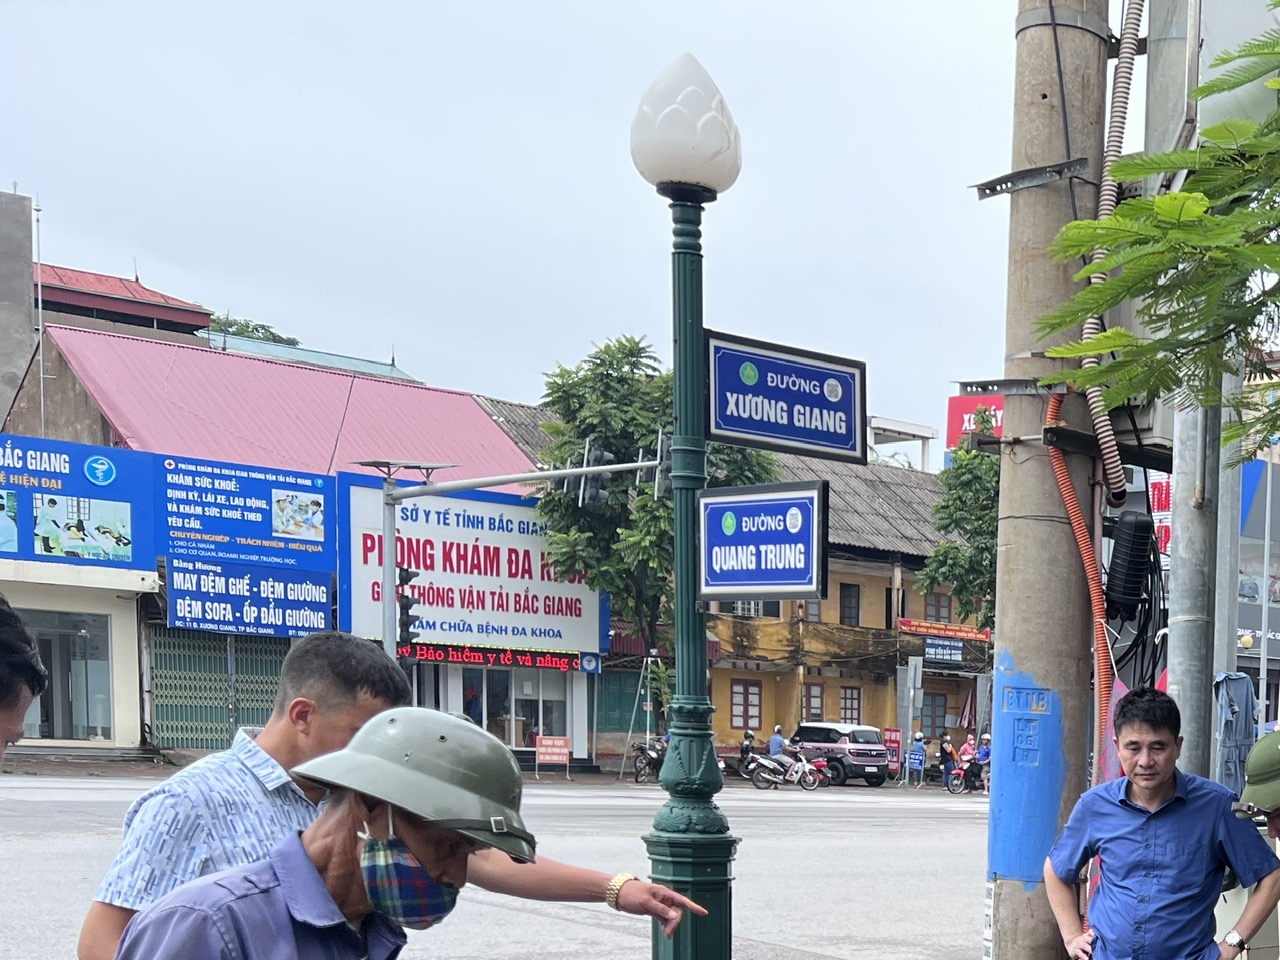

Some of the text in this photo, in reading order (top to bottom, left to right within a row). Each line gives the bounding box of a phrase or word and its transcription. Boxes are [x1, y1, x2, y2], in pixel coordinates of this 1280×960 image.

[766, 372, 821, 395] ĐƯỜNG
[725, 391, 847, 435] XƯƠNG GIANG
[26, 450, 70, 474] GIANG
[10, 473, 38, 489] HIỆN
[41, 478, 63, 491] ĐẠI
[166, 473, 193, 487] KHÁM
[194, 476, 212, 488] SỨC
[166, 488, 187, 500] ĐỊNH
[202, 492, 215, 502] LÁI
[216, 494, 229, 506] XE,
[230, 496, 244, 506] LAO
[166, 502, 262, 522] VÀ KHÁM SỨC KHOẺ THEO
[167, 516, 182, 527] YÊU
[400, 503, 420, 522] SỞ
[423, 510, 432, 524] Y
[435, 508, 451, 526] TẾ
[454, 509, 484, 530] TỈNH
[488, 513, 514, 533] BẮC
[742, 512, 784, 532] ĐƯỜNG
[442, 537, 501, 578] KHÁM
[507, 547, 534, 580] ĐA
[712, 543, 805, 574] QUANG TRUNG
[172, 572, 198, 591] MAY
[200, 572, 226, 597] ĐỆM
[228, 574, 251, 597] GHẾ
[260, 578, 285, 602] ĐỆM
[287, 580, 327, 604] GIƯỜNG
[409, 581, 455, 609] THÔNG
[458, 584, 486, 614] VẬN
[490, 584, 510, 613] TẢI
[514, 586, 540, 615] BẮC
[544, 595, 582, 618] GIANG
[176, 596, 202, 622] ĐỆM
[204, 601, 234, 622] SOFA
[242, 600, 258, 624] ỐP
[260, 602, 283, 626] ĐẦU
[286, 606, 326, 629] GIƯỜNG
[246, 624, 258, 634] BẮC
[258, 627, 275, 635] GIANG
[440, 620, 474, 634] CHỮA
[477, 622, 508, 638] BỆNH
[511, 626, 528, 637] ĐA
[530, 628, 563, 639] KHOA
[416, 645, 445, 660] Bảo
[486, 652, 497, 667] y
[516, 652, 532, 666] và
[536, 654, 569, 672] nâng
